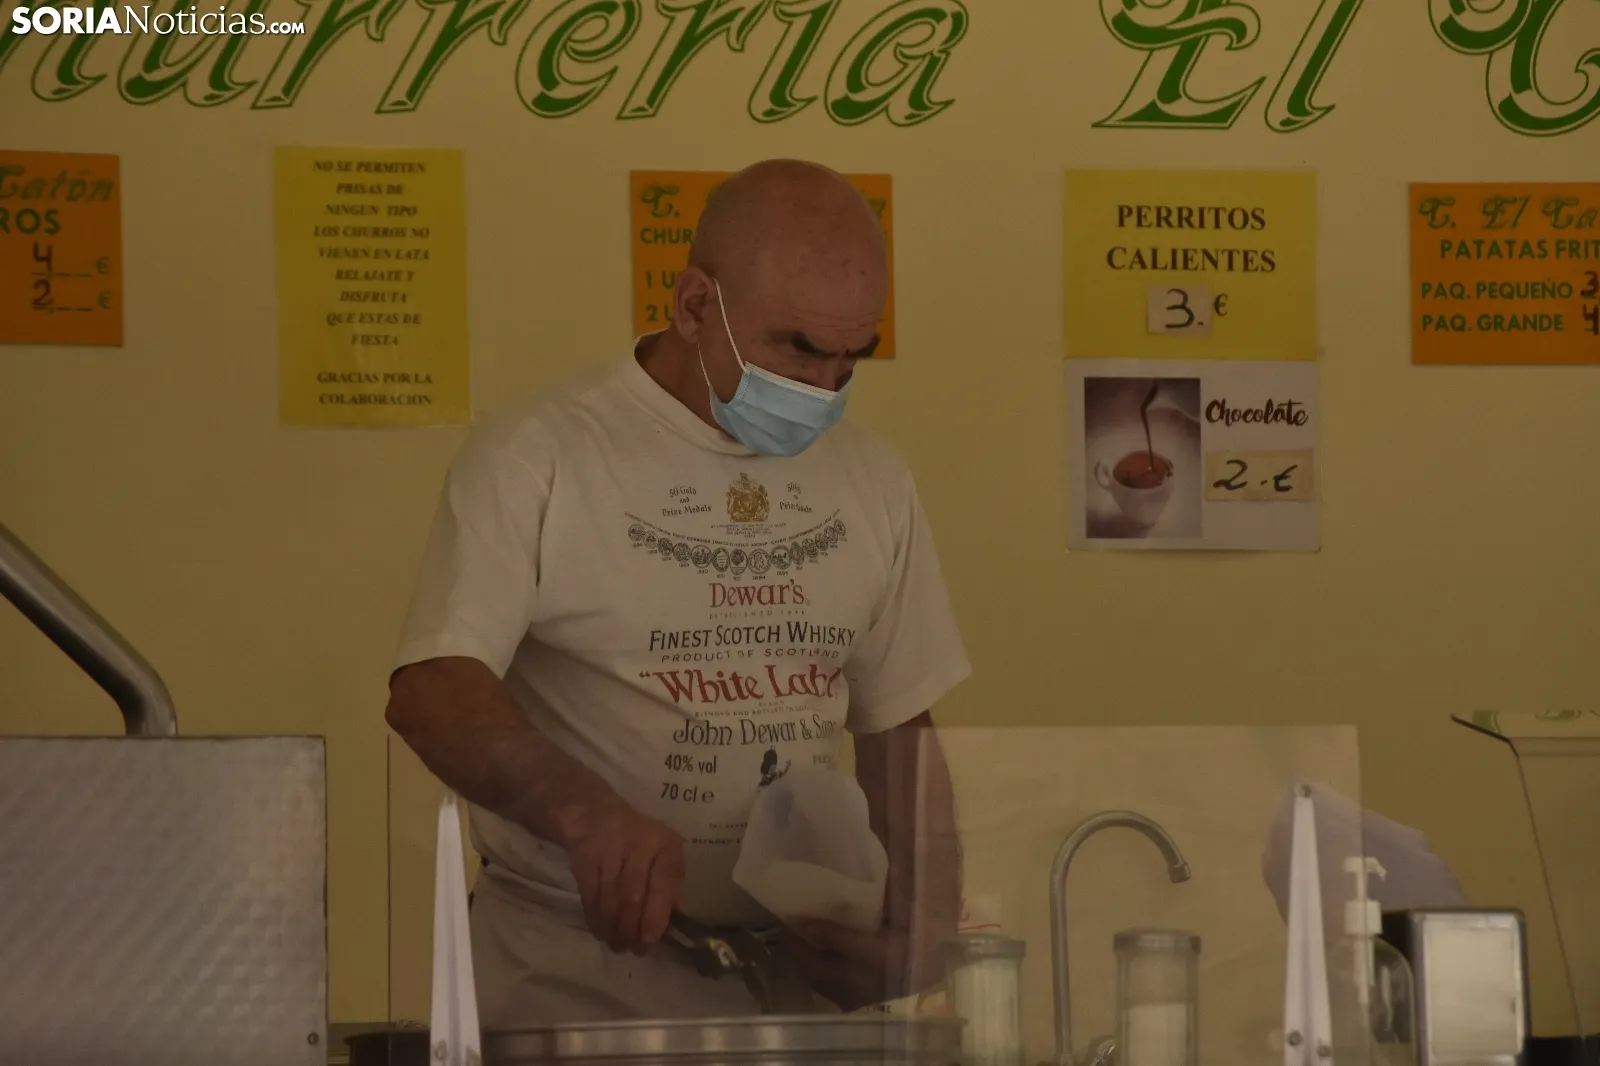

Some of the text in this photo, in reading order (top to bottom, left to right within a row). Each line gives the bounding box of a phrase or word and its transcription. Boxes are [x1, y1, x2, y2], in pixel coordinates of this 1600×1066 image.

[312, 159, 426, 174] NO SE PERMITEN
[336, 182, 404, 196] PRISAS DE
[325, 203, 417, 217] NINGUN TIPO
[1117, 204, 1267, 231] PERRITOS
[314, 226, 430, 239] LOS CHURROS NO
[319, 247, 430, 260] VIENEN EN LATA
[1439, 239, 1549, 260] PATATAS
[1106, 246, 1276, 273] CALIENTES
[335, 269, 416, 281] RELAJATE Y
[340, 291, 407, 303] DISFRUTA
[1421, 282, 1471, 300] PAQ.
[326, 312, 421, 326] QUE ESTAS DE
[646, 304, 657, 323] 2
[1421, 314, 1472, 333] PAQ.
[1477, 313, 1565, 333] GRANDE
[352, 334, 399, 346] FIESTA
[317, 372, 433, 384] GRACIAS POR LA
[319, 393, 432, 406] COLABORACION
[1205, 398, 1308, 427] Chocolate
[662, 504, 712, 518] Prize Medals
[709, 579, 805, 608] Dewar's
[661, 653, 731, 663] PRODUCT
[673, 719, 733, 746] John
[740, 718, 797, 746] Dewar
[800, 718, 812, 740] &
[665, 754, 717, 774] 40% vol
[660, 783, 679, 800] 70
[683, 786, 697, 803] cl
